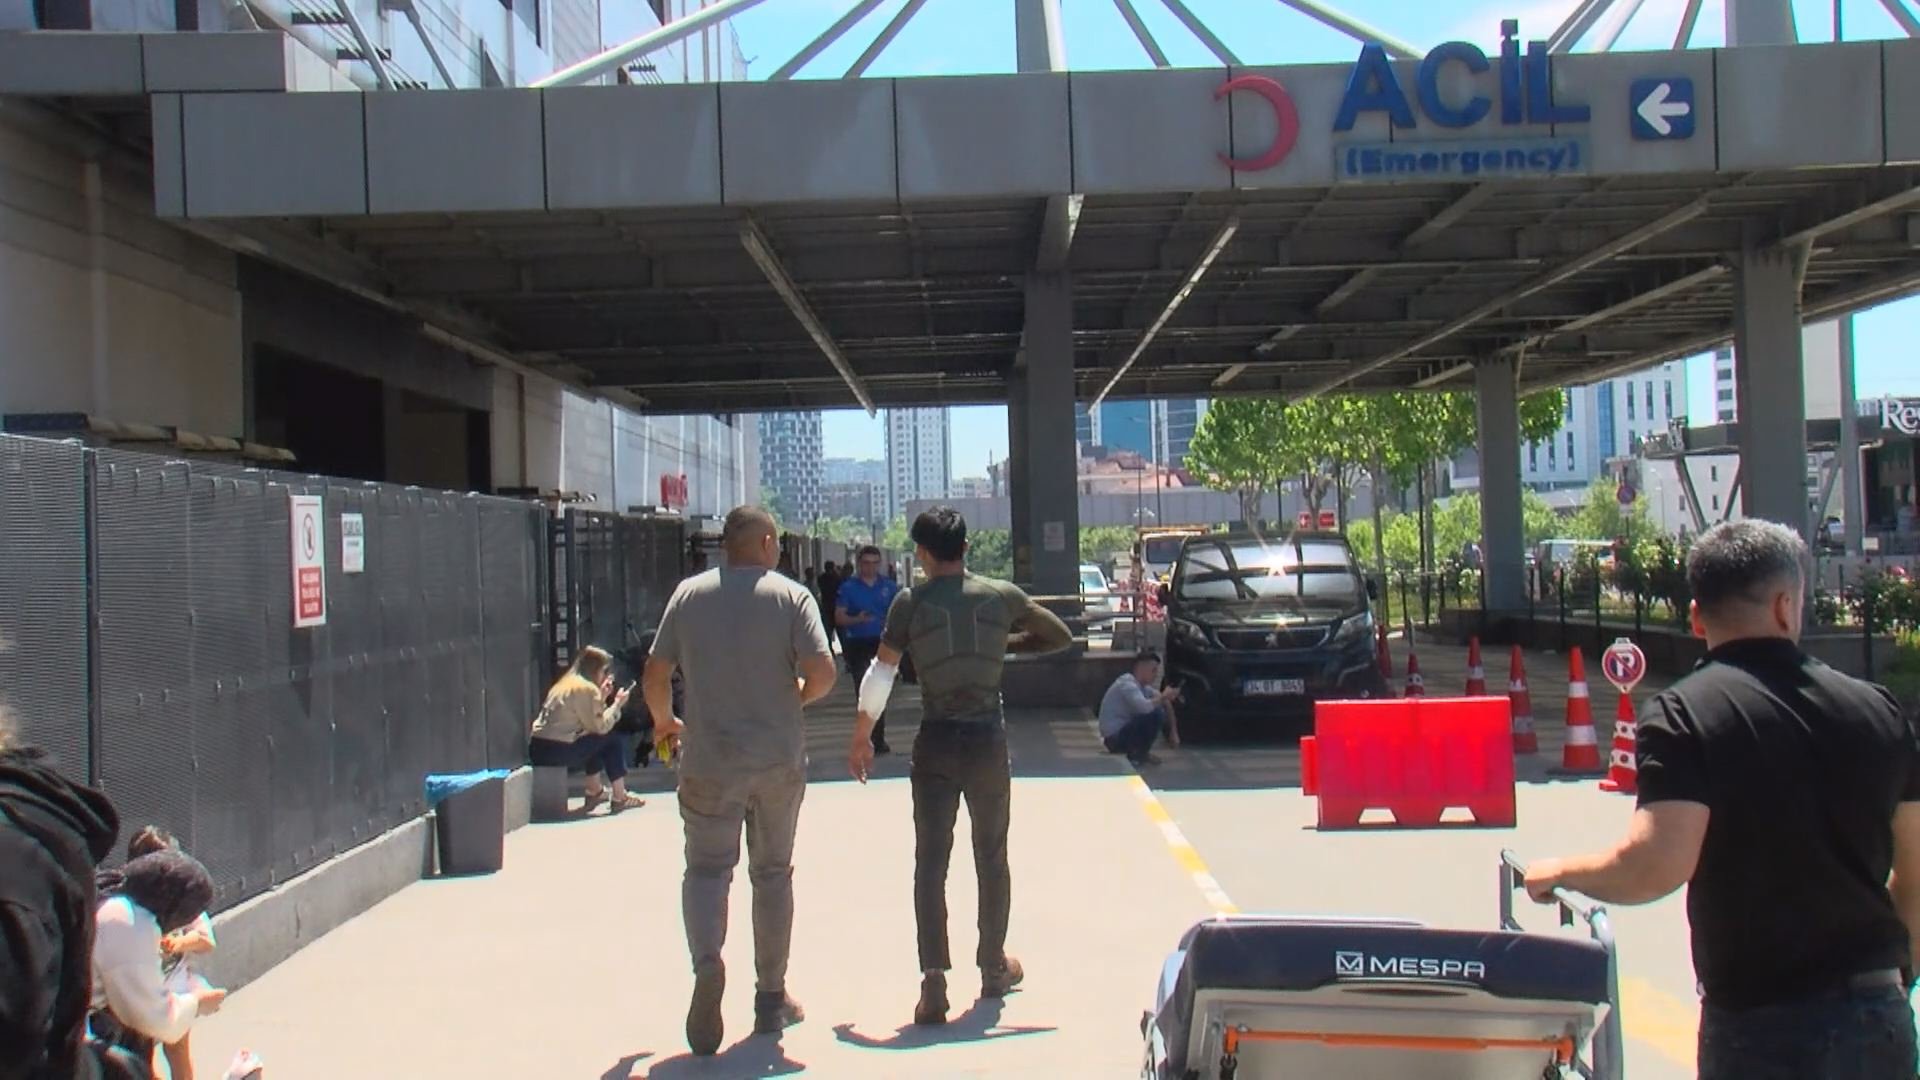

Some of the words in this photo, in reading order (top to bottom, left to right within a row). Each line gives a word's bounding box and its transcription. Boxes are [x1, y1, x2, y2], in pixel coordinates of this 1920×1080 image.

[1333, 19, 1591, 132] ACİL
[1345, 140, 1580, 176] (Emergency)
[1880, 399, 1920, 434] Re
[1369, 956, 1485, 978] MESPA
